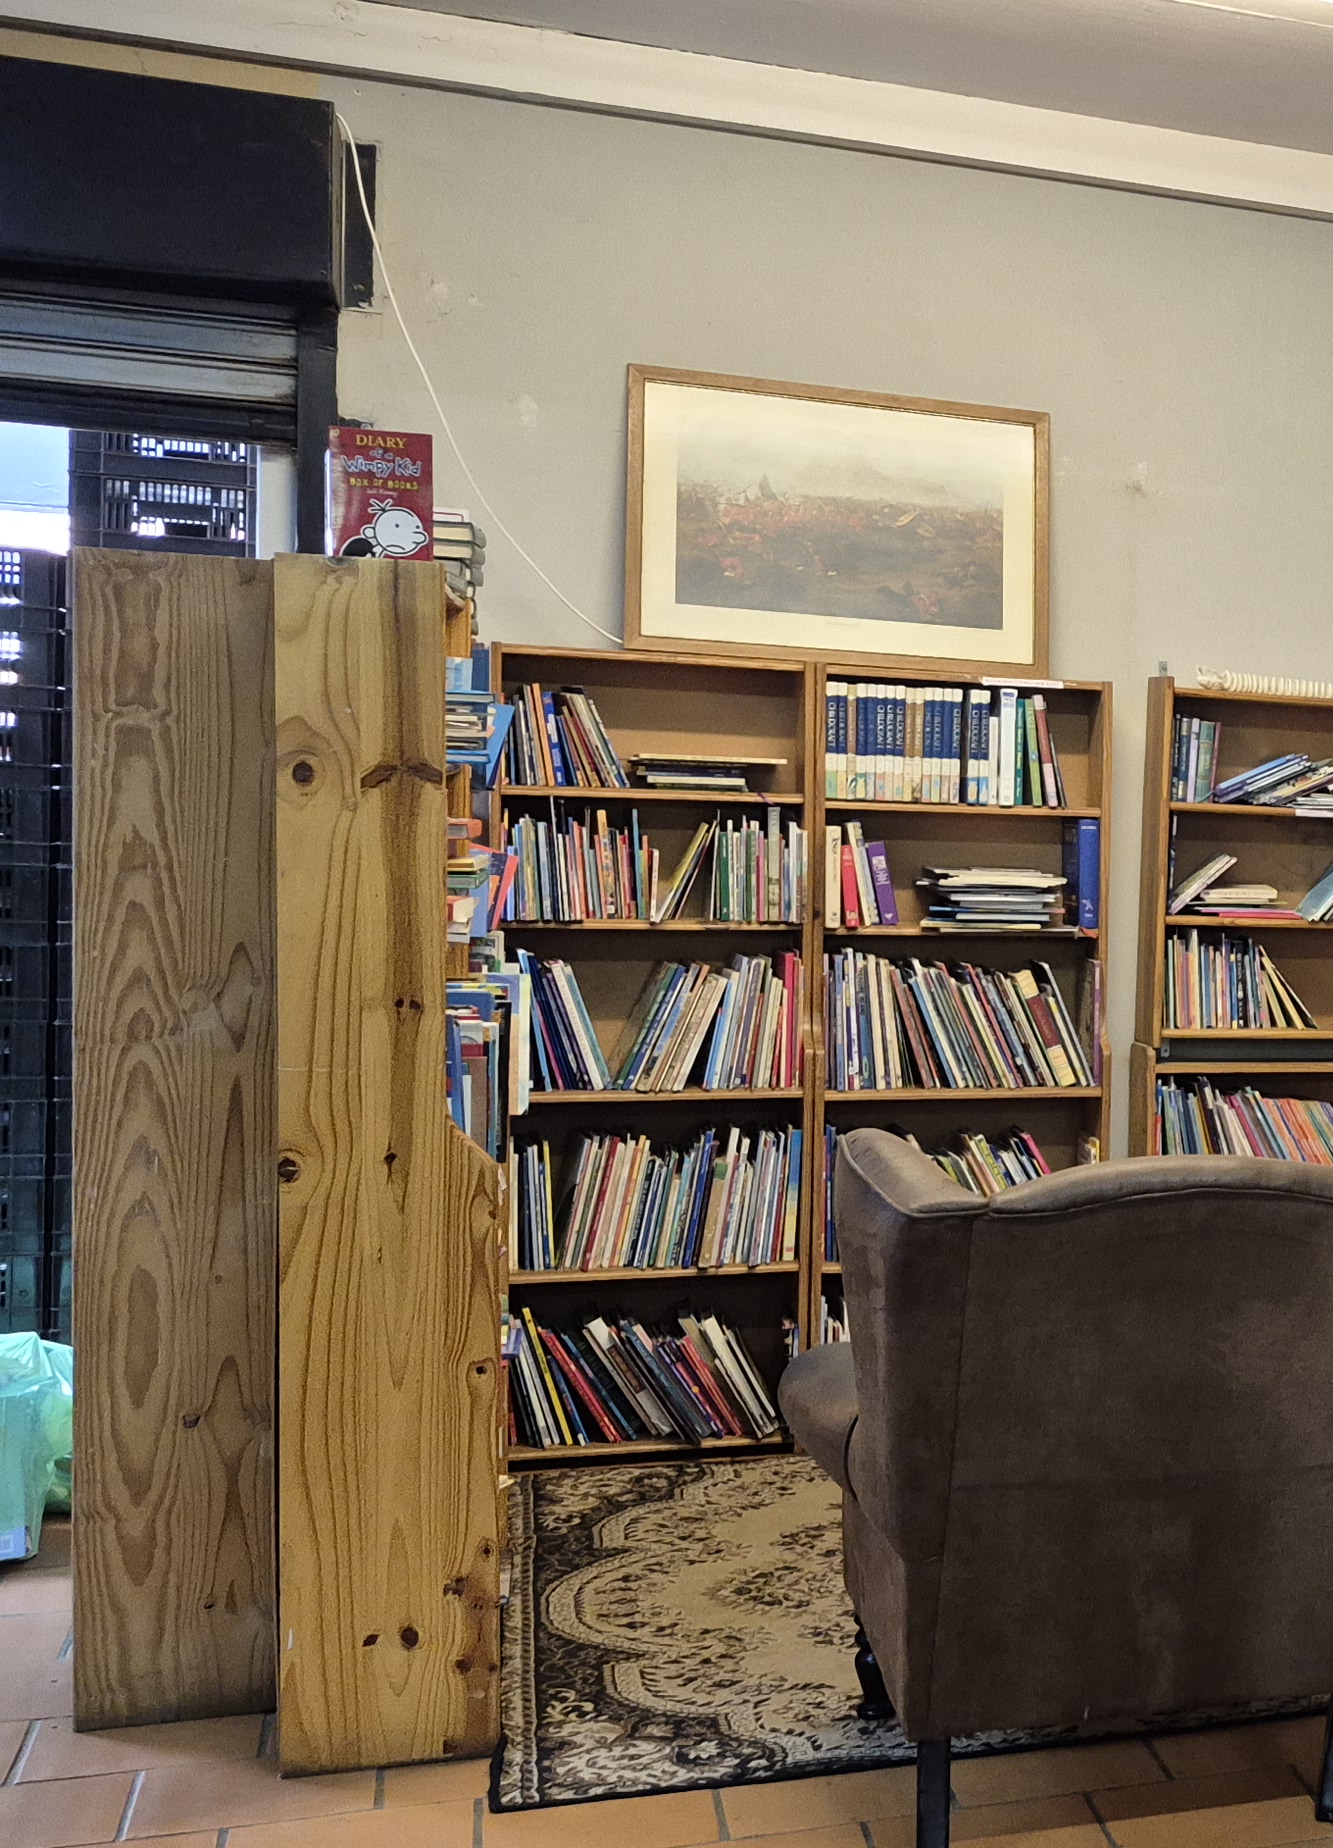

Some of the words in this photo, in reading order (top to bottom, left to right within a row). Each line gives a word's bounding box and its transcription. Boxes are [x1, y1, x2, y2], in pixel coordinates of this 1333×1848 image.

[355, 434, 407, 449] DIARY
[341, 454, 393, 478] Wimpy
[396, 456, 422, 477] Kid
[350, 477, 369, 487] BOX
[373, 478, 385, 487] OF
[387, 480, 419, 491] BOOKS
